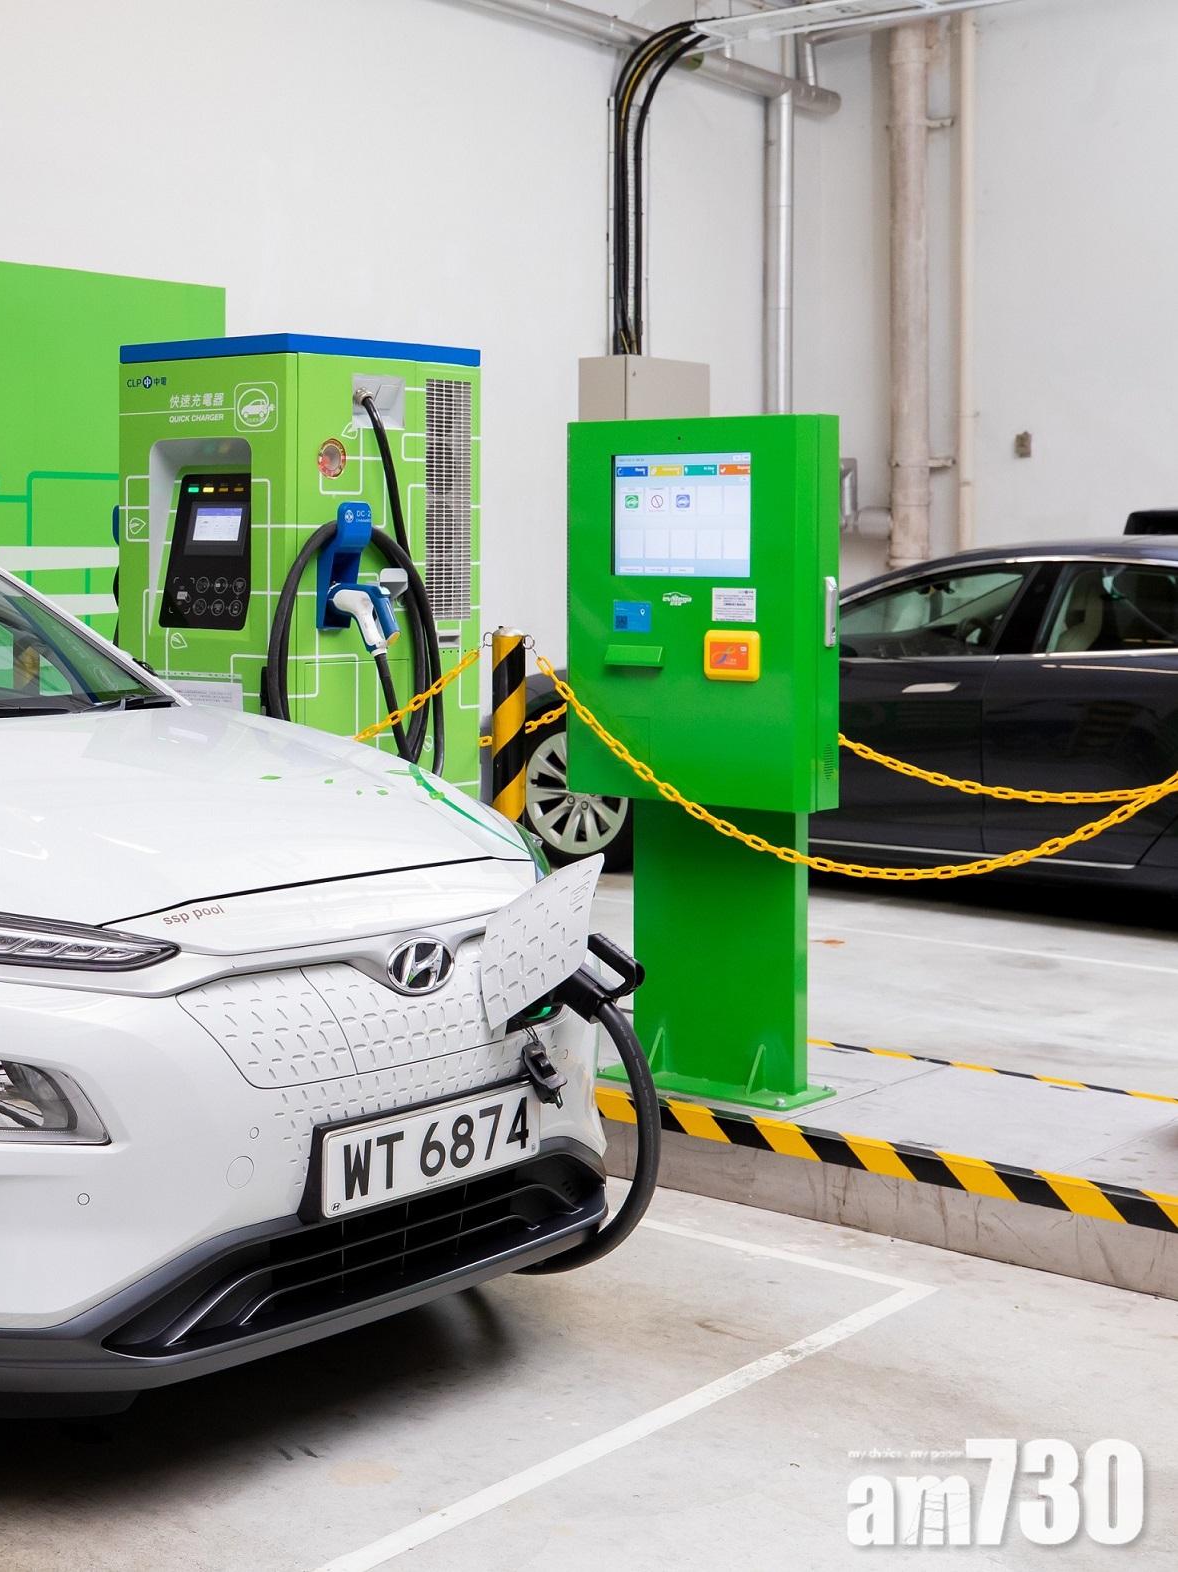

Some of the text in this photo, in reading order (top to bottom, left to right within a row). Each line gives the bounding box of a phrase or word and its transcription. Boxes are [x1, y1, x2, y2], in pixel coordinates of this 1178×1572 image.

[127, 378, 141, 388] CLP
[169, 392, 224, 409] 快速充電器
[169, 413, 224, 423] QUICK CHARGER
[163, 904, 225, 925] ssp pool
[343, 1096, 529, 1200] WT 6874
